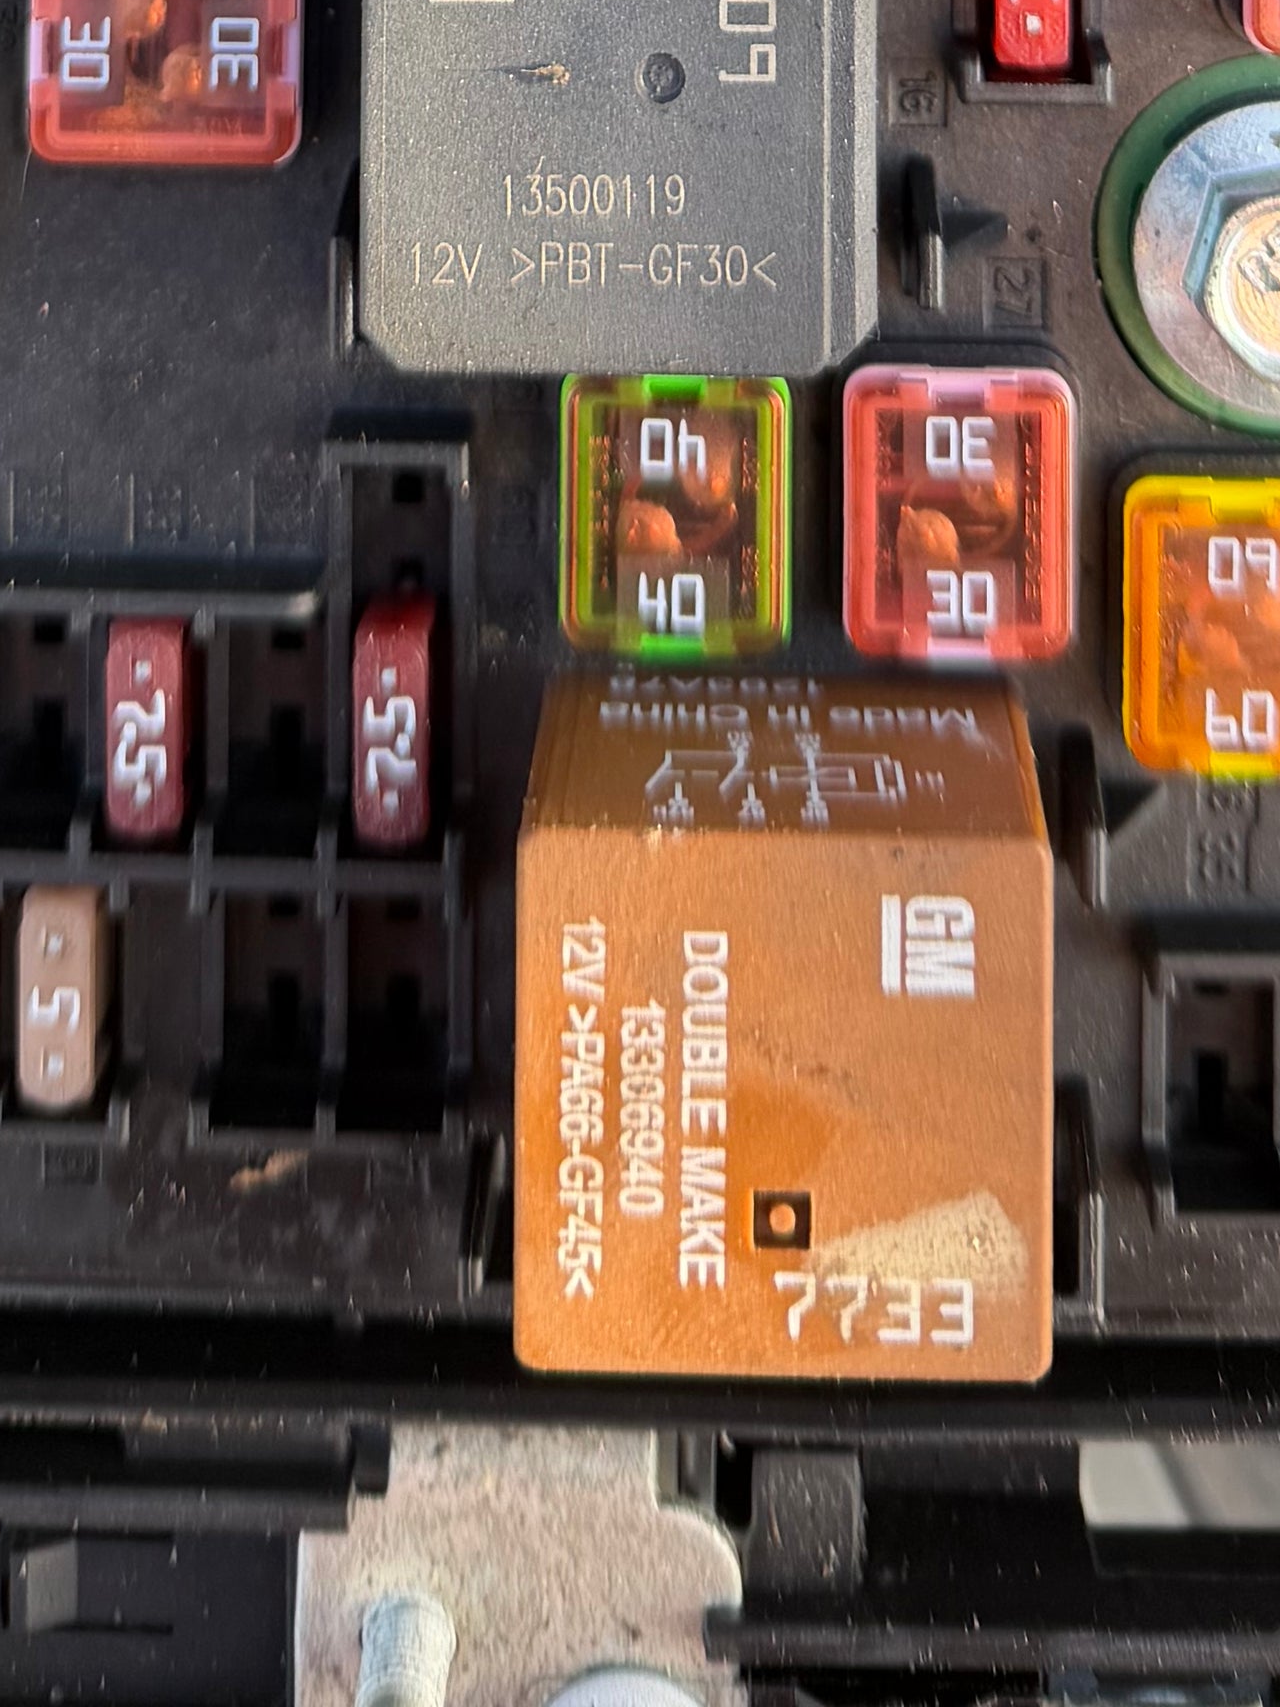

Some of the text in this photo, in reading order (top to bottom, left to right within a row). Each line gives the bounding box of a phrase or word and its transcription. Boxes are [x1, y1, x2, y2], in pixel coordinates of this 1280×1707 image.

[61, 16, 111, 90] 30
[211, 17, 260, 90] 30
[502, 174, 686, 219] 13500119
[410, 242, 482, 286] 12V
[641, 417, 706, 478] 40
[926, 418, 994, 469] 30
[1207, 537, 1277, 590] 60
[639, 573, 706, 634] 40
[926, 573, 994, 624] 30
[1206, 690, 1277, 743] 60
[561, 916, 607, 1002] 12V
[906, 896, 975, 998] GM
[26, 987, 80, 1031] 5
[619, 998, 666, 1219] 13306940
[678, 931, 728, 1289] DOUBLE MAKE
